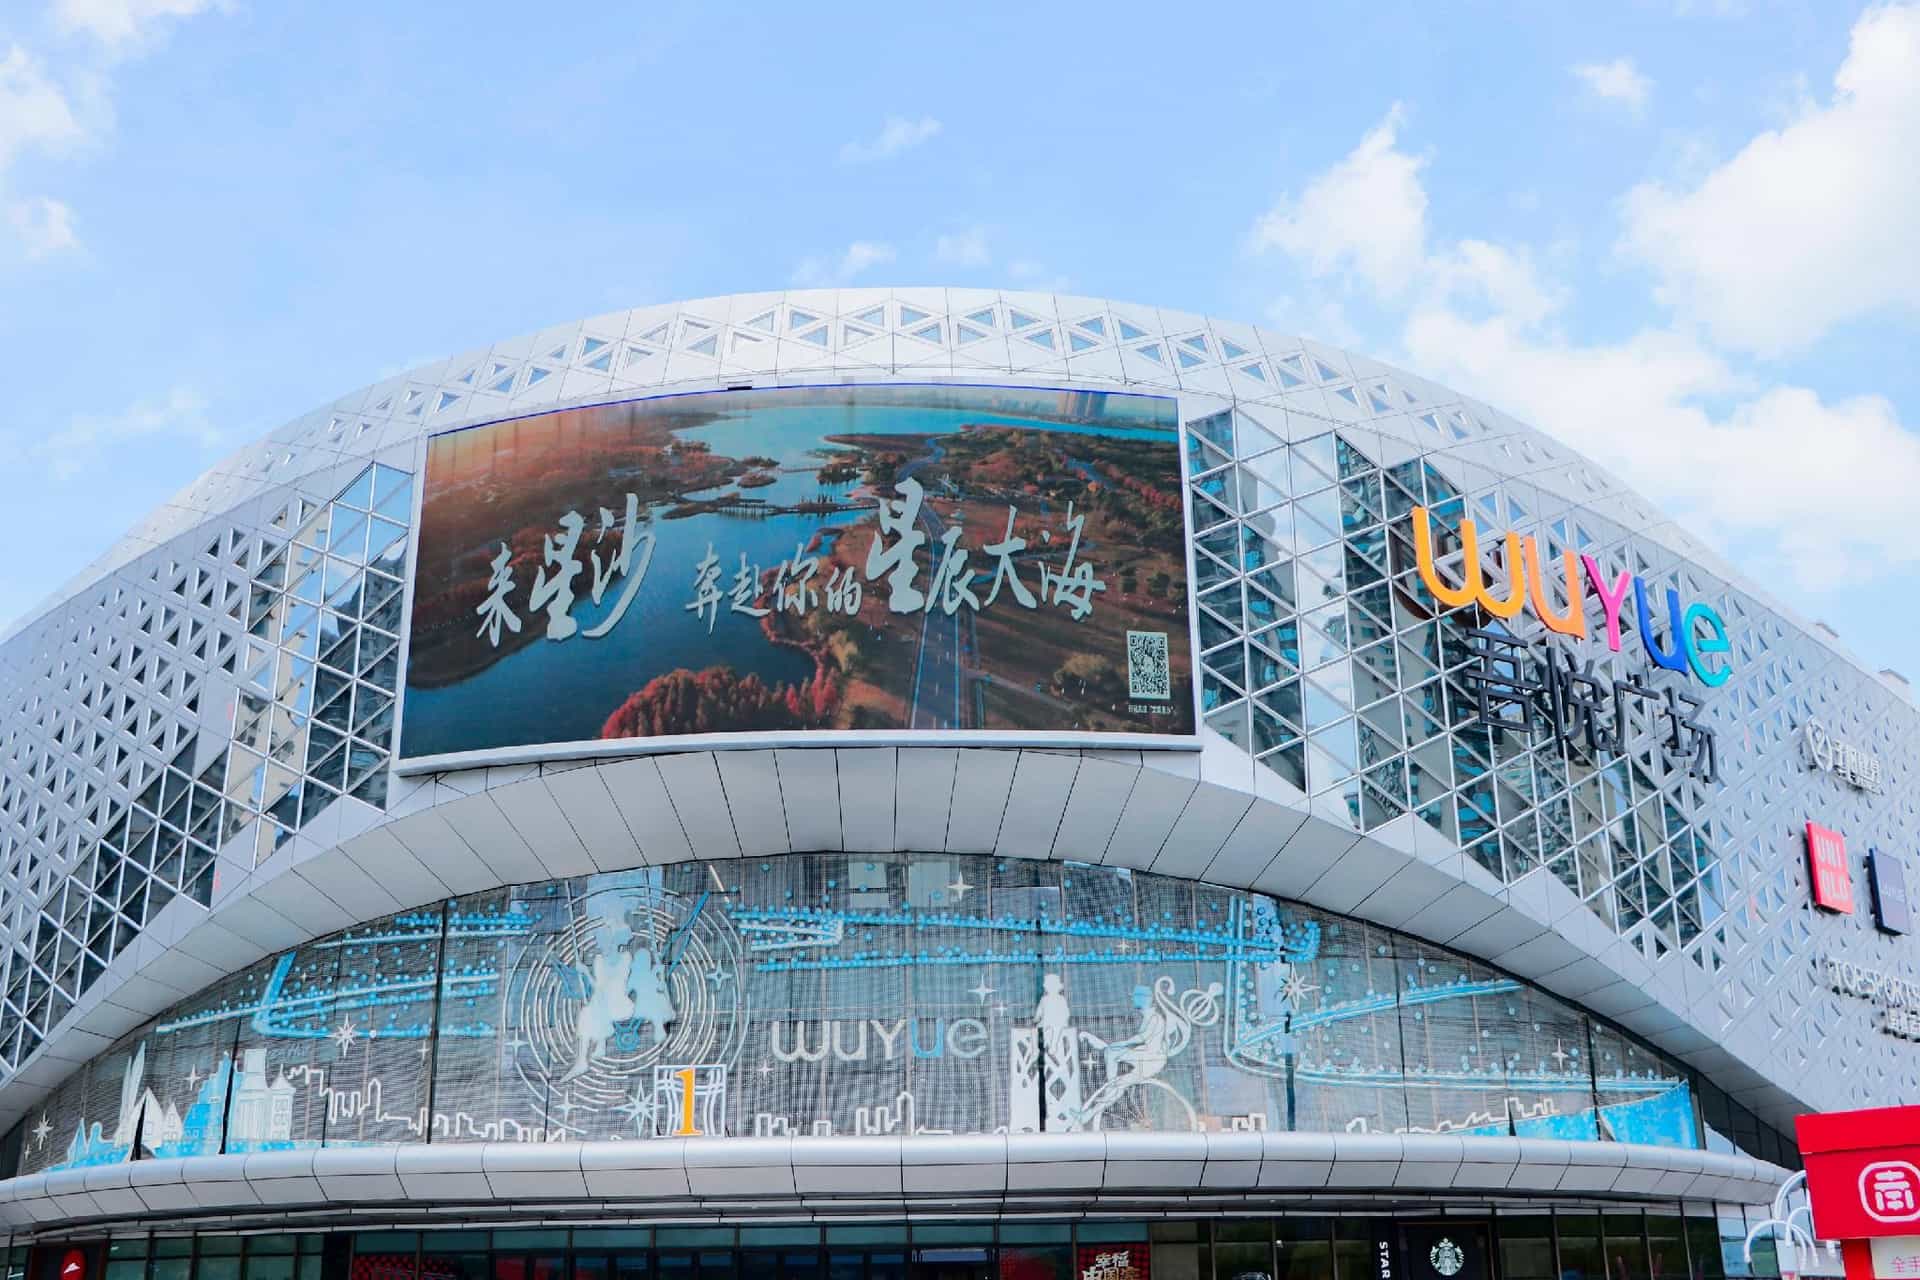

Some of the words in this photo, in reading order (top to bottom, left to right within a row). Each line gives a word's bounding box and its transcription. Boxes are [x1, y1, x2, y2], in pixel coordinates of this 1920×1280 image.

[476, 493, 656, 647] 来星沙
[684, 477, 1106, 634] 奔赴你的星辰大海
[1465, 627, 1719, 784] 吾悦广场
[1815, 834, 1842, 869] UNI
[1379, 1241, 1390, 1279] STAR
